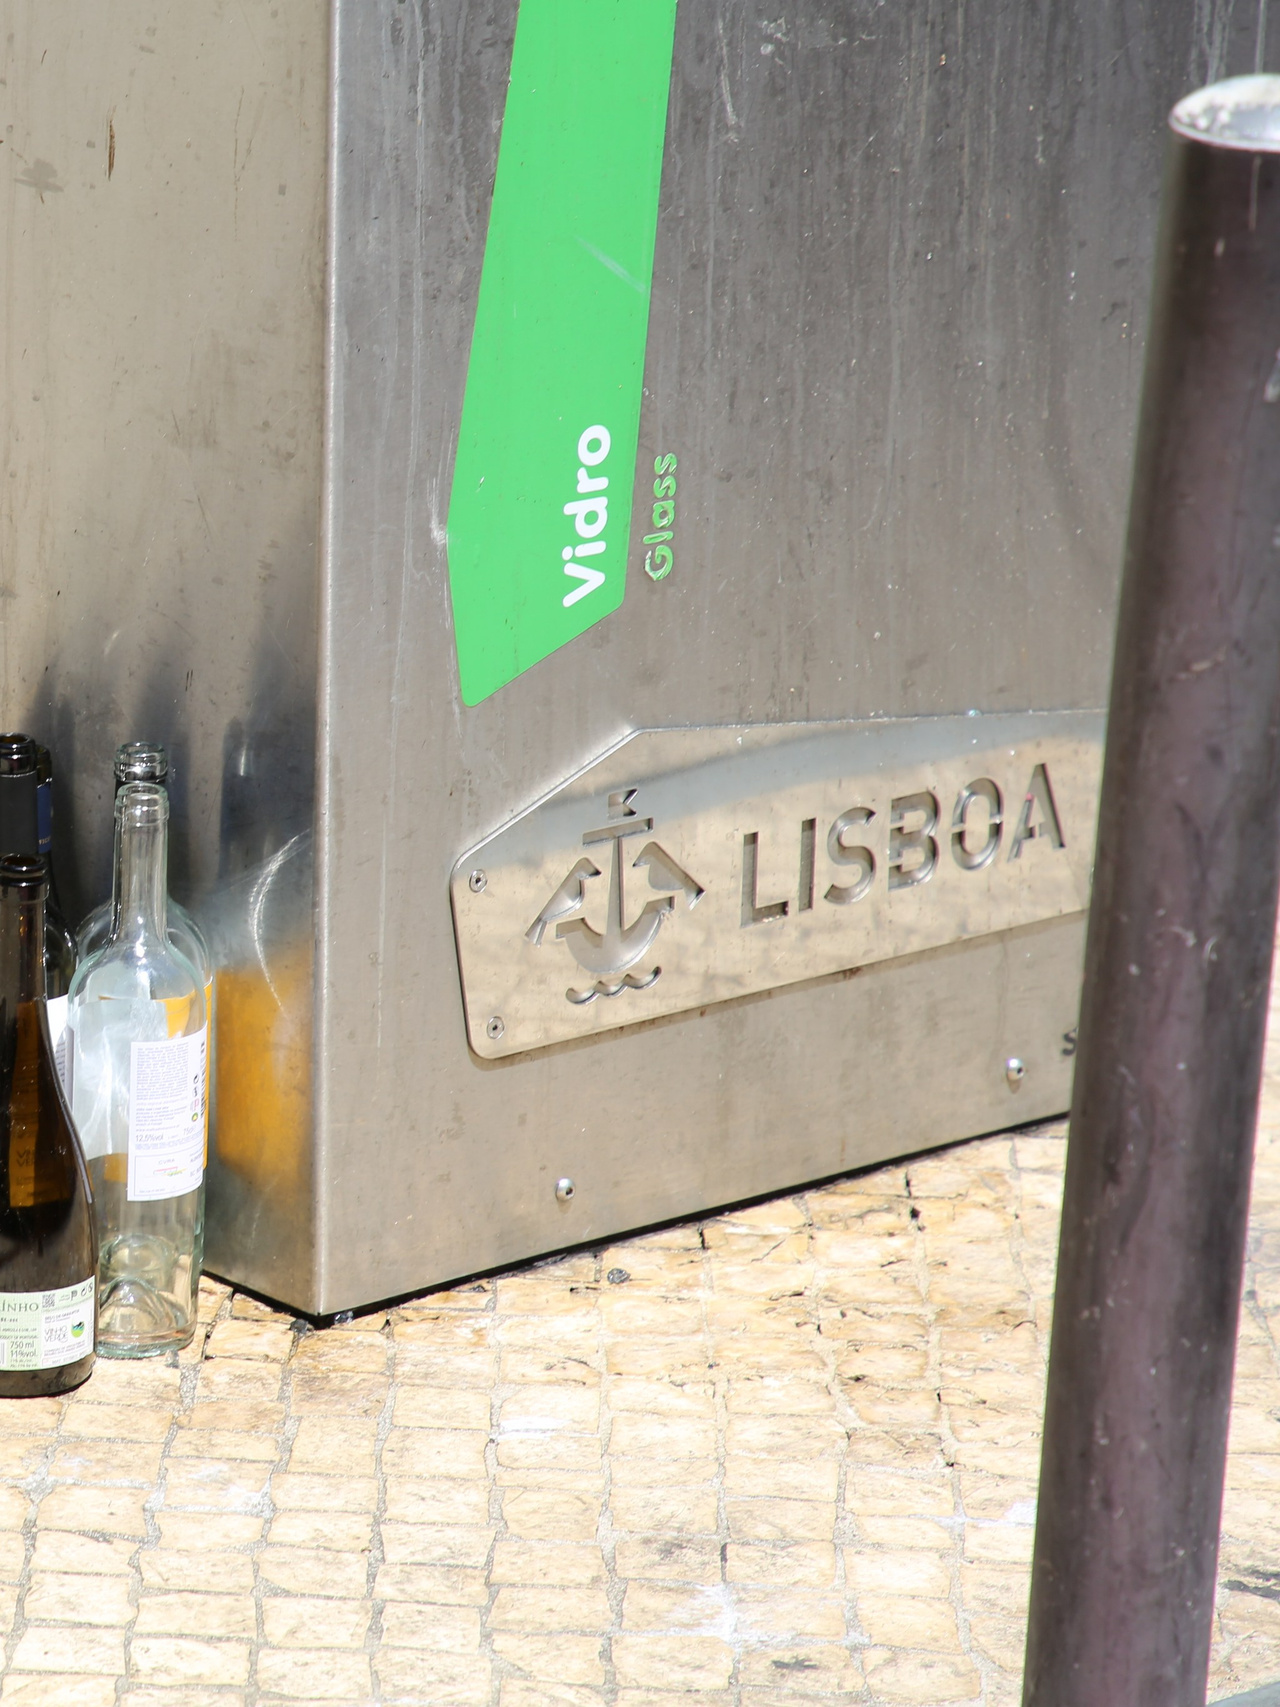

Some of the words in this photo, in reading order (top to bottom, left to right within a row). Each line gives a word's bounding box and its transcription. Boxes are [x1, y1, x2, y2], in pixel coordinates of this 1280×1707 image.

[562, 424, 611, 608] Vidro
[642, 452, 678, 582] Glass
[739, 762, 1067, 929] LISBOA
[10, 1340, 24, 1349] 750
